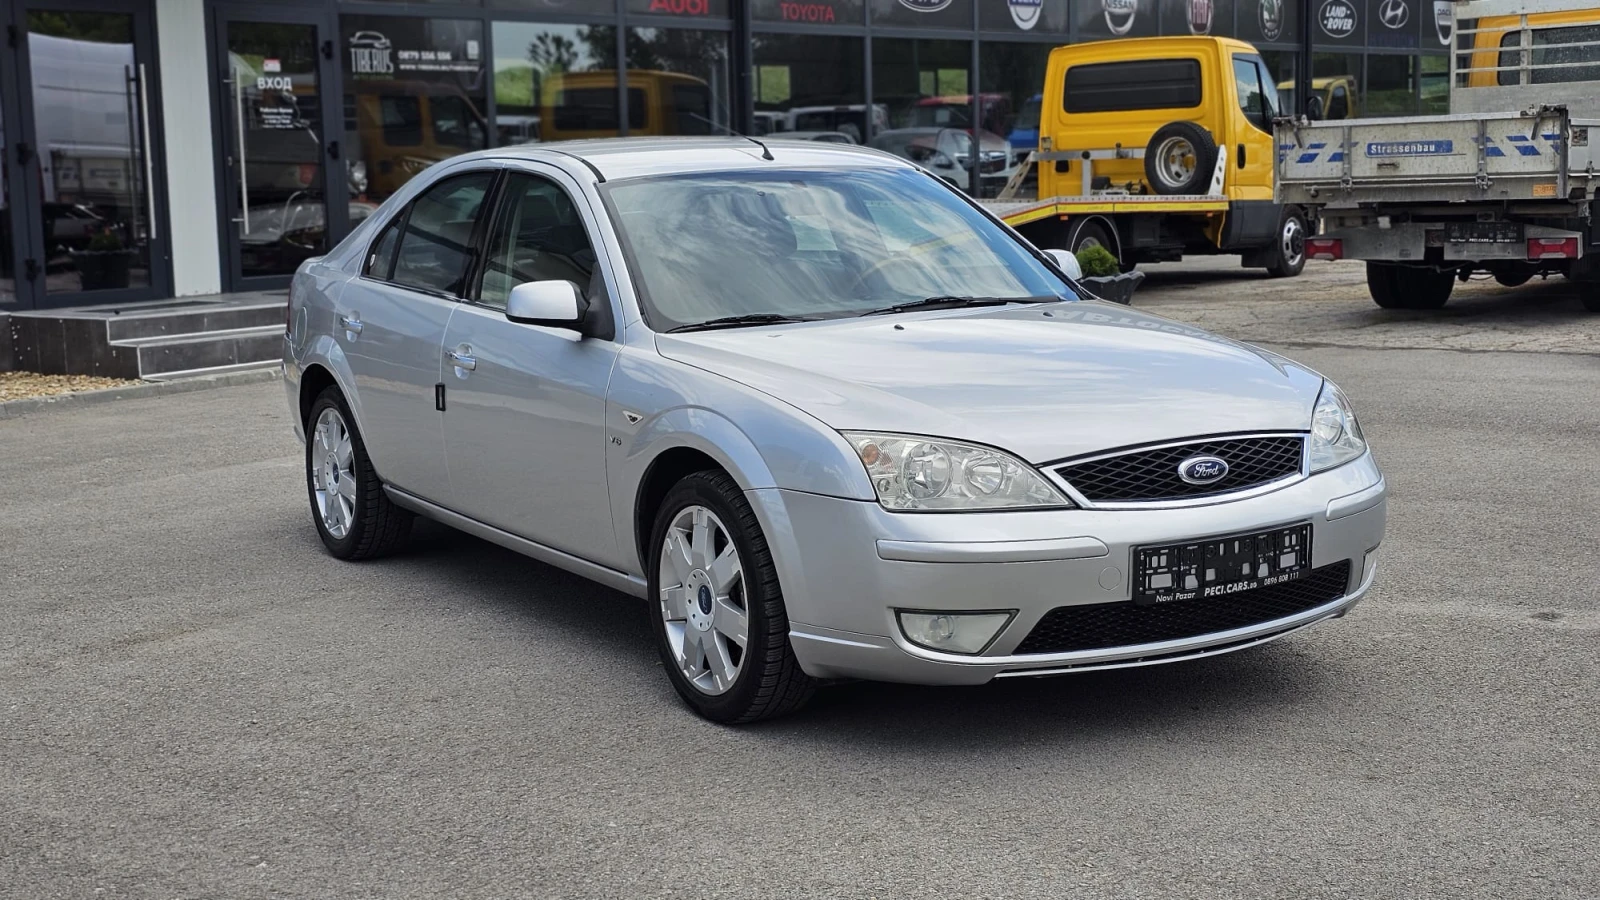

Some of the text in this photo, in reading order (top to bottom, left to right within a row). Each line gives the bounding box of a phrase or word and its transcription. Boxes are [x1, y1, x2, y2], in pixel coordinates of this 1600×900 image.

[780, 3, 835, 21] TOYOTA
[1325, 5, 1346, 17] LAND
[1326, 19, 1353, 30] ROVER
[349, 48, 395, 73] TIBERUS
[257, 77, 292, 91] ВХОД
[1371, 144, 1435, 154] Strassenbau
[1194, 462, 1219, 478] Ford
[1156, 593, 1173, 603] Novi
[1175, 592, 1196, 600] Pazar
[1264, 577, 1278, 586] 0896
[1278, 575, 1289, 584] 808
[1290, 571, 1299, 580] 111
